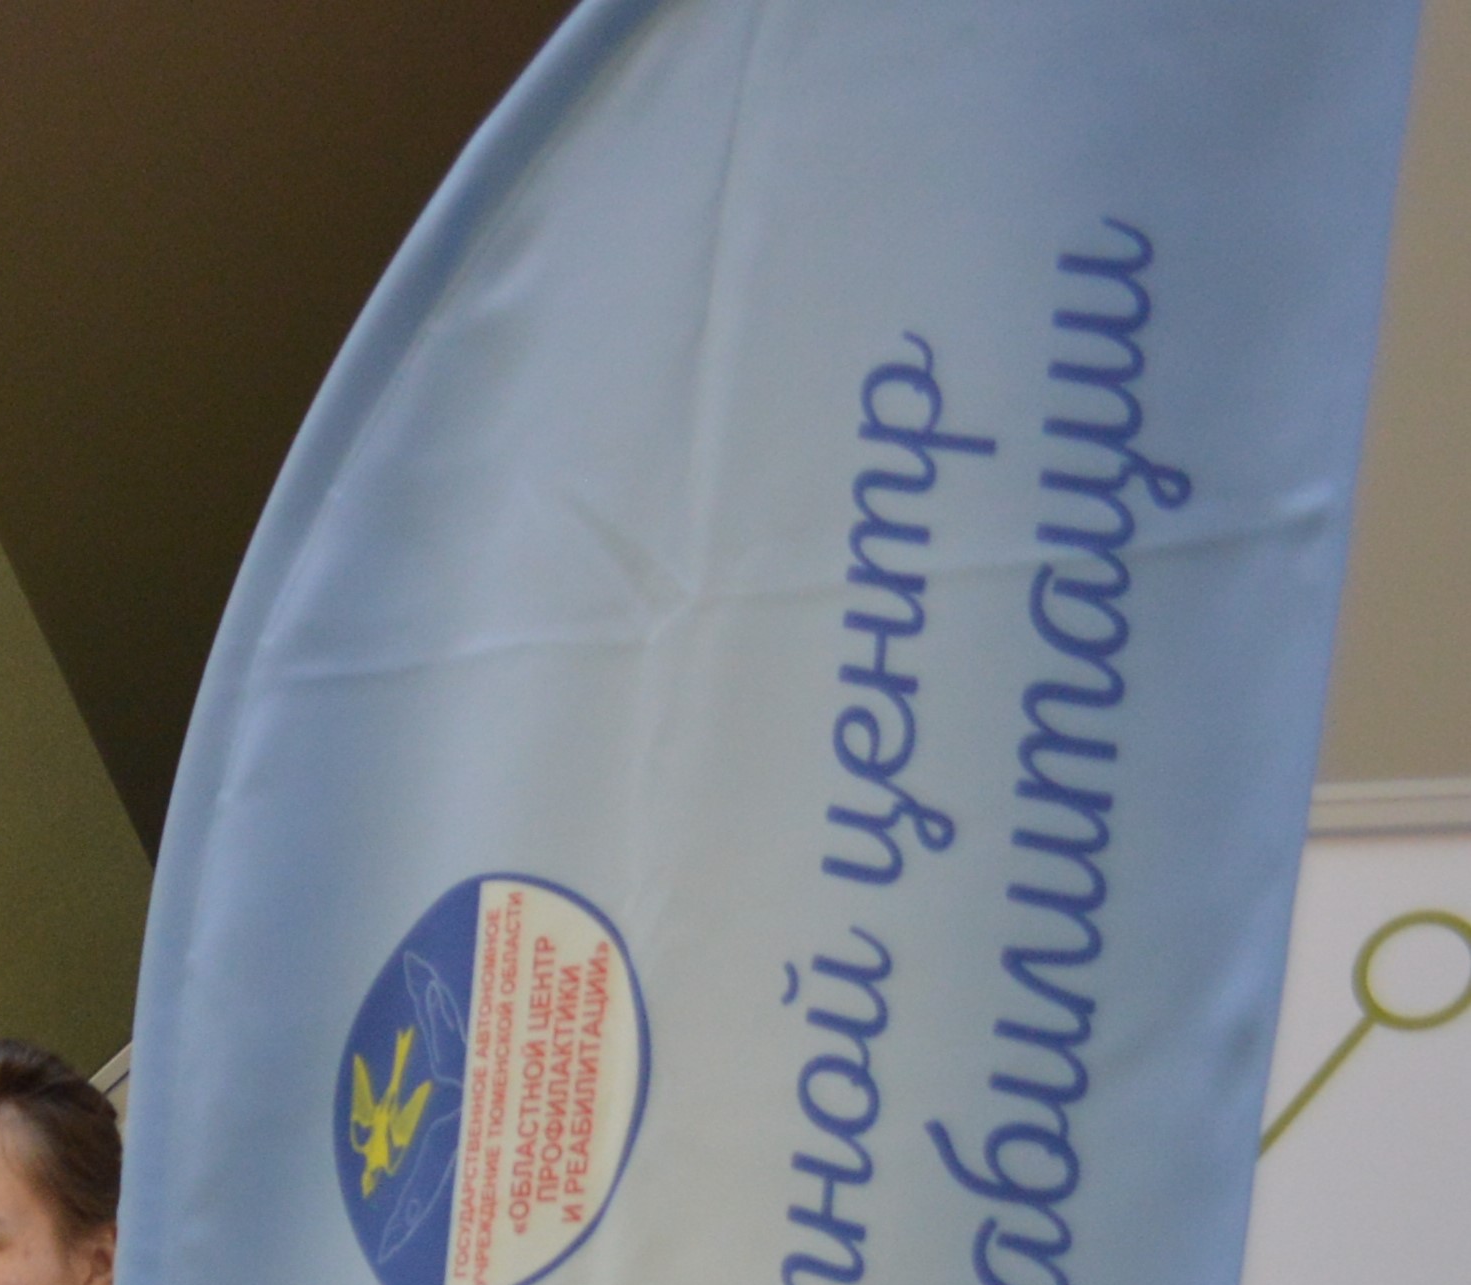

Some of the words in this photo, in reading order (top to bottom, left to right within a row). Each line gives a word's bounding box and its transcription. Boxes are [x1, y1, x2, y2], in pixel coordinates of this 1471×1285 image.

[820, 330, 997, 886] центр
[500, 890, 524, 996] ОБЛАСТИ
[528, 935, 557, 1032] ЦЕНТР
[454, 1067, 488, 1279] ГОСУДАРСТВЕННОЕ
[475, 908, 501, 1058] АВТОНОМНОЕ
[488, 1004, 514, 1139] ТЮМЕНСКОЙ
[509, 1038, 548, 1236] «ОБЛАСТНОЙ
[537, 964, 583, 1204] ПРОФИЛАКТИКИ
[565, 940, 611, 1197] РЕАБИЛИТАЦИИ»
[562, 1203, 582, 1224] И
